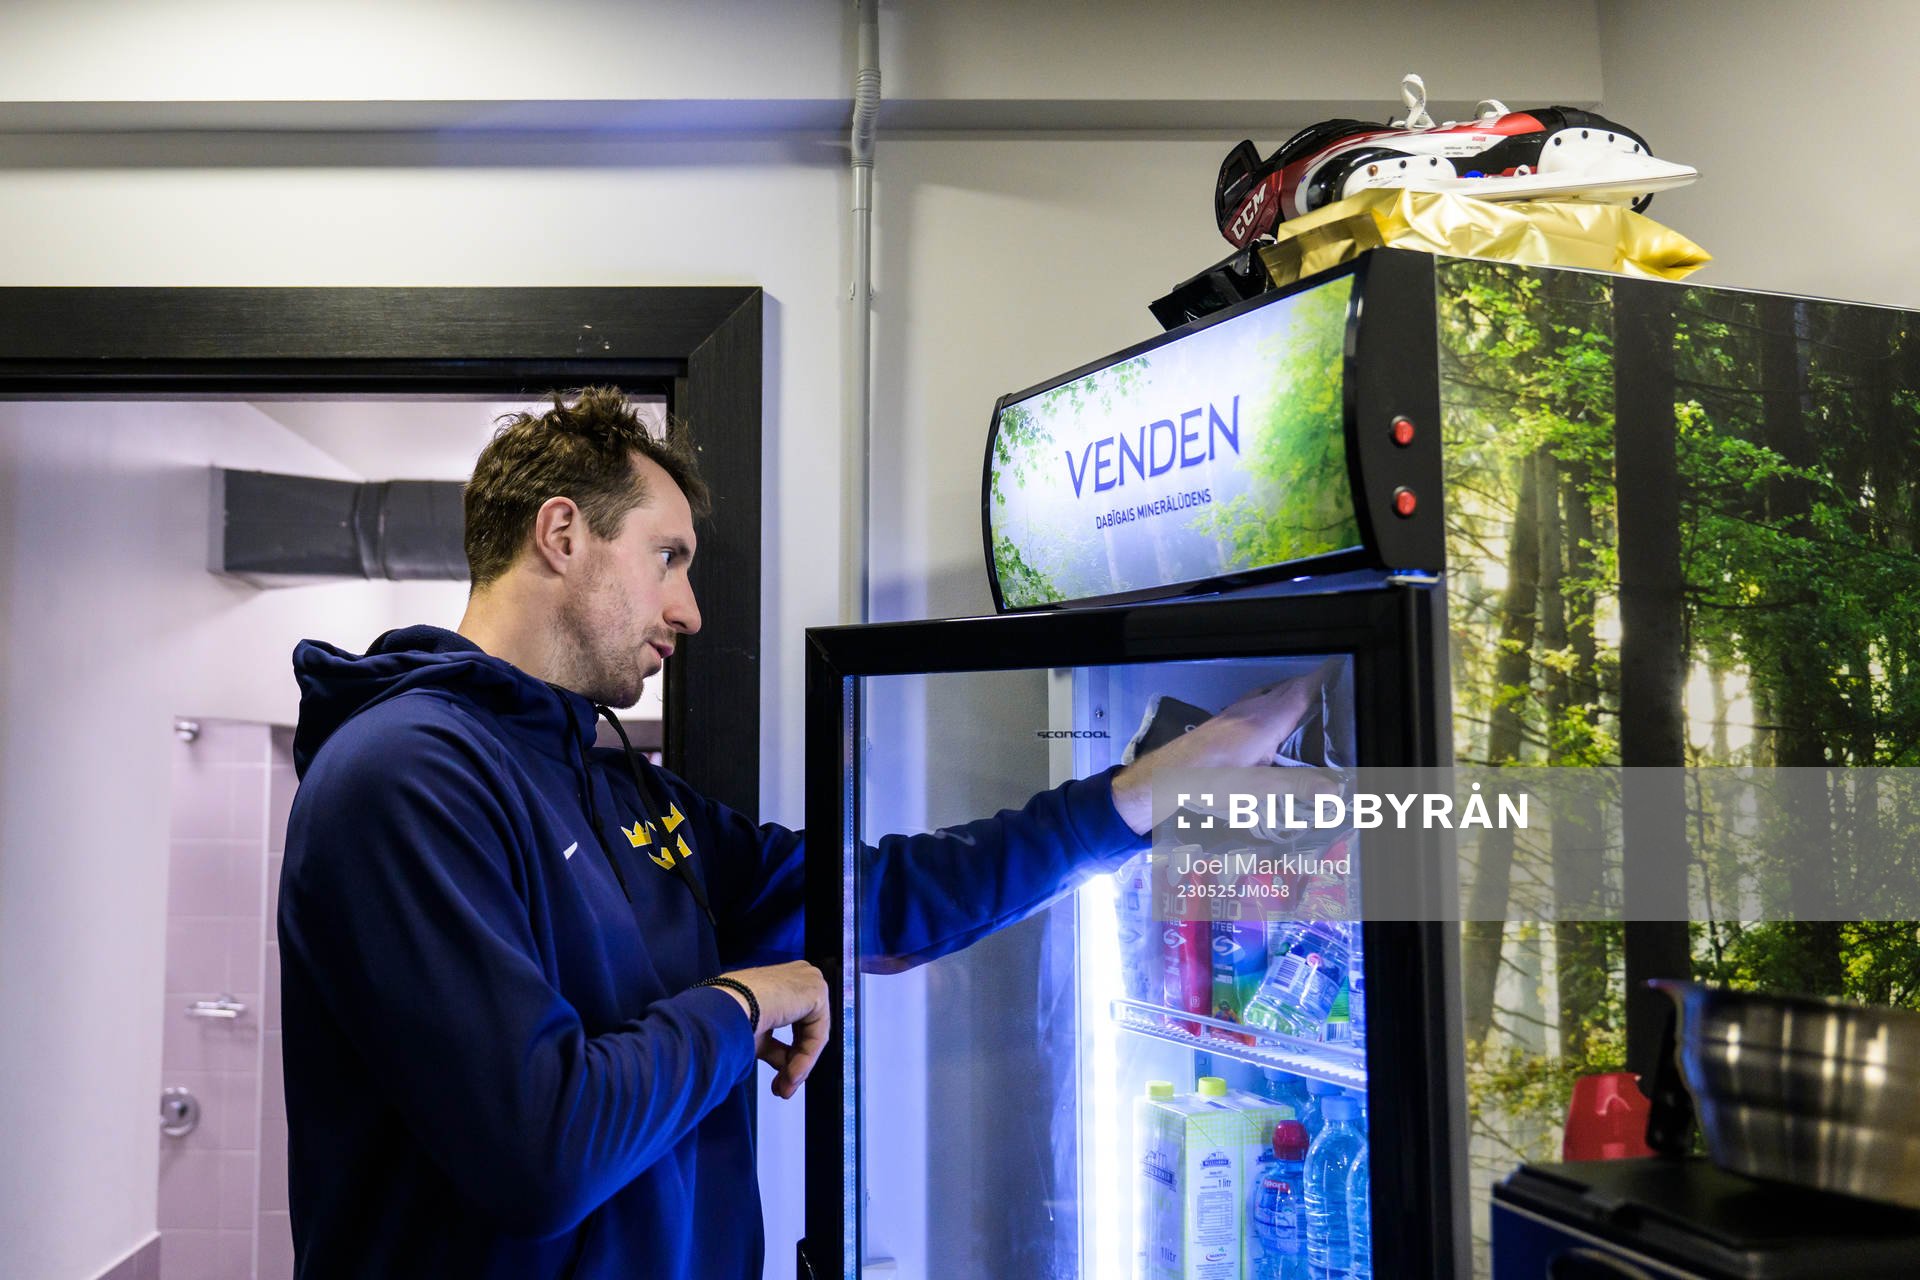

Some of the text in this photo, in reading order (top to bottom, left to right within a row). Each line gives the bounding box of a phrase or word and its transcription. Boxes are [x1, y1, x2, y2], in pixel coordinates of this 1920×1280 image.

[1231, 183, 1267, 240] CCM
[1065, 395, 1240, 499] VENDEN
[1095, 488, 1212, 529] DABĪGAIS MINERĀLŪDENS
